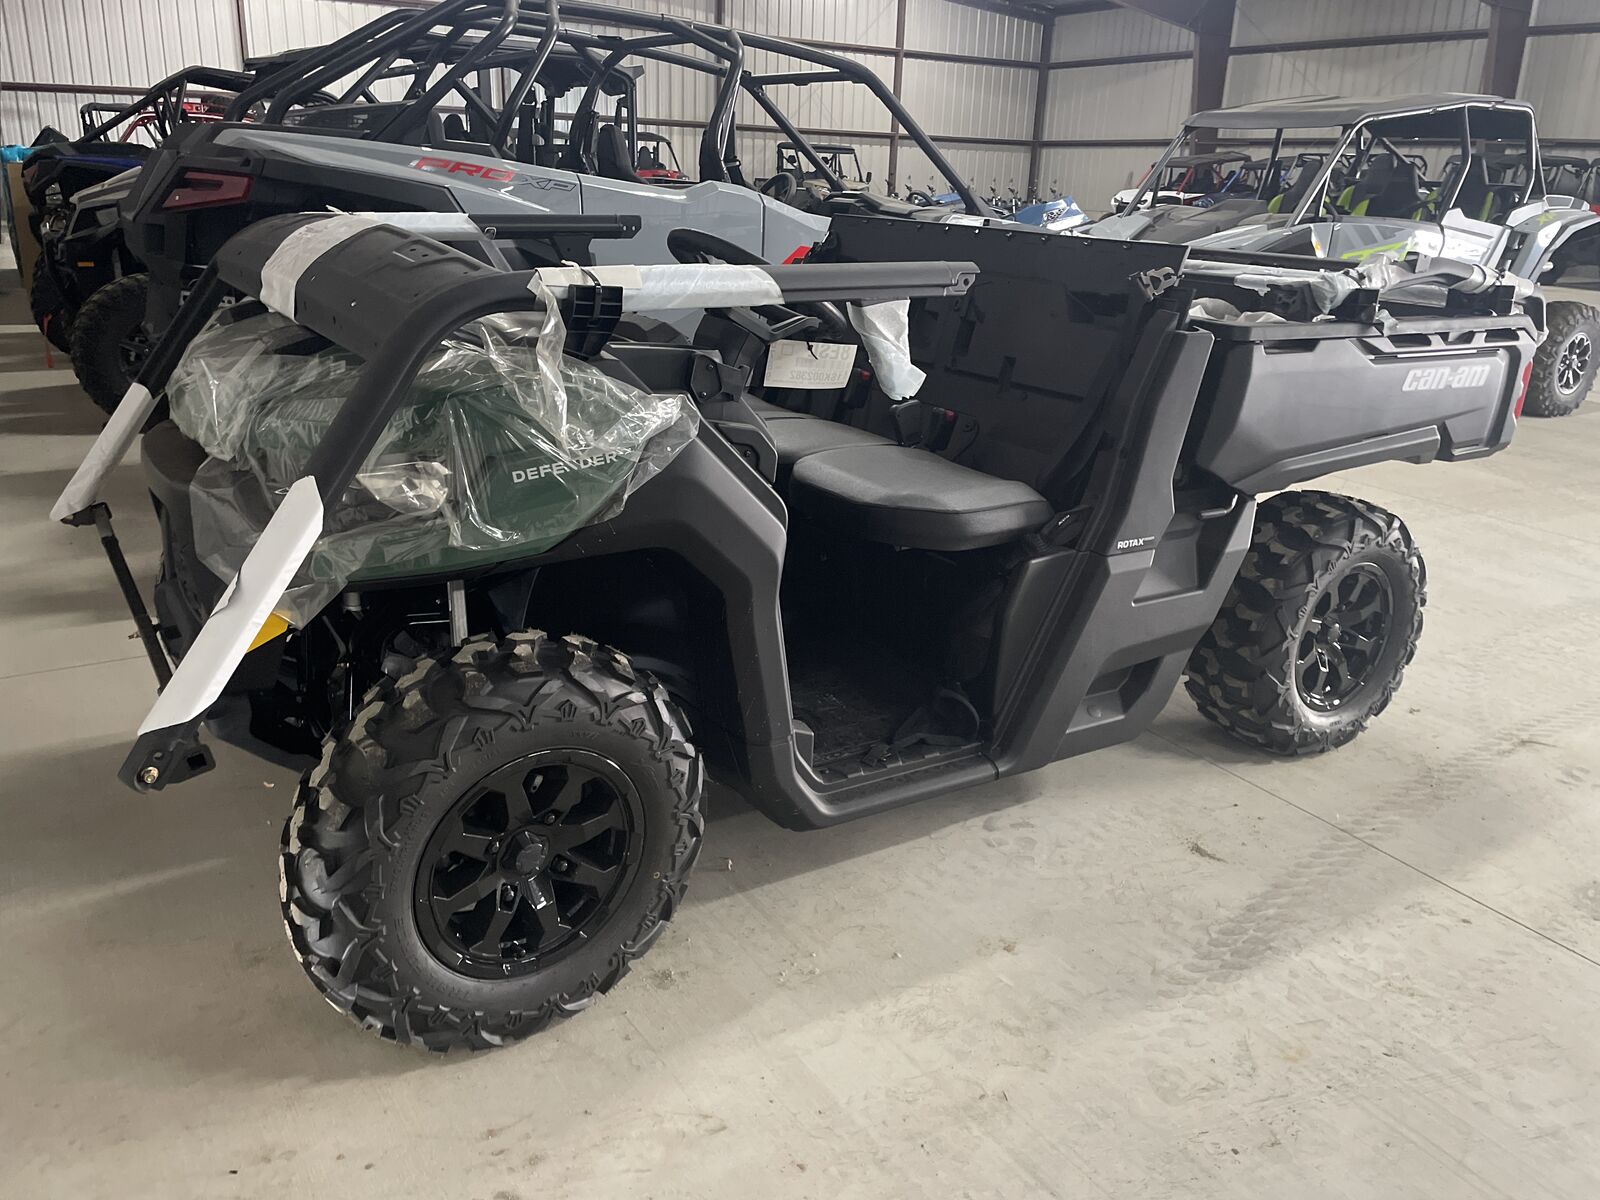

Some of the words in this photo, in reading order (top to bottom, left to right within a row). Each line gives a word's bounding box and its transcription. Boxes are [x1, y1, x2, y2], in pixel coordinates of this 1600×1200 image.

[415, 156, 515, 182] PRO
[519, 175, 577, 191] XP
[1402, 365, 1490, 391] can-am
[1117, 538, 1144, 549] ROTAX
